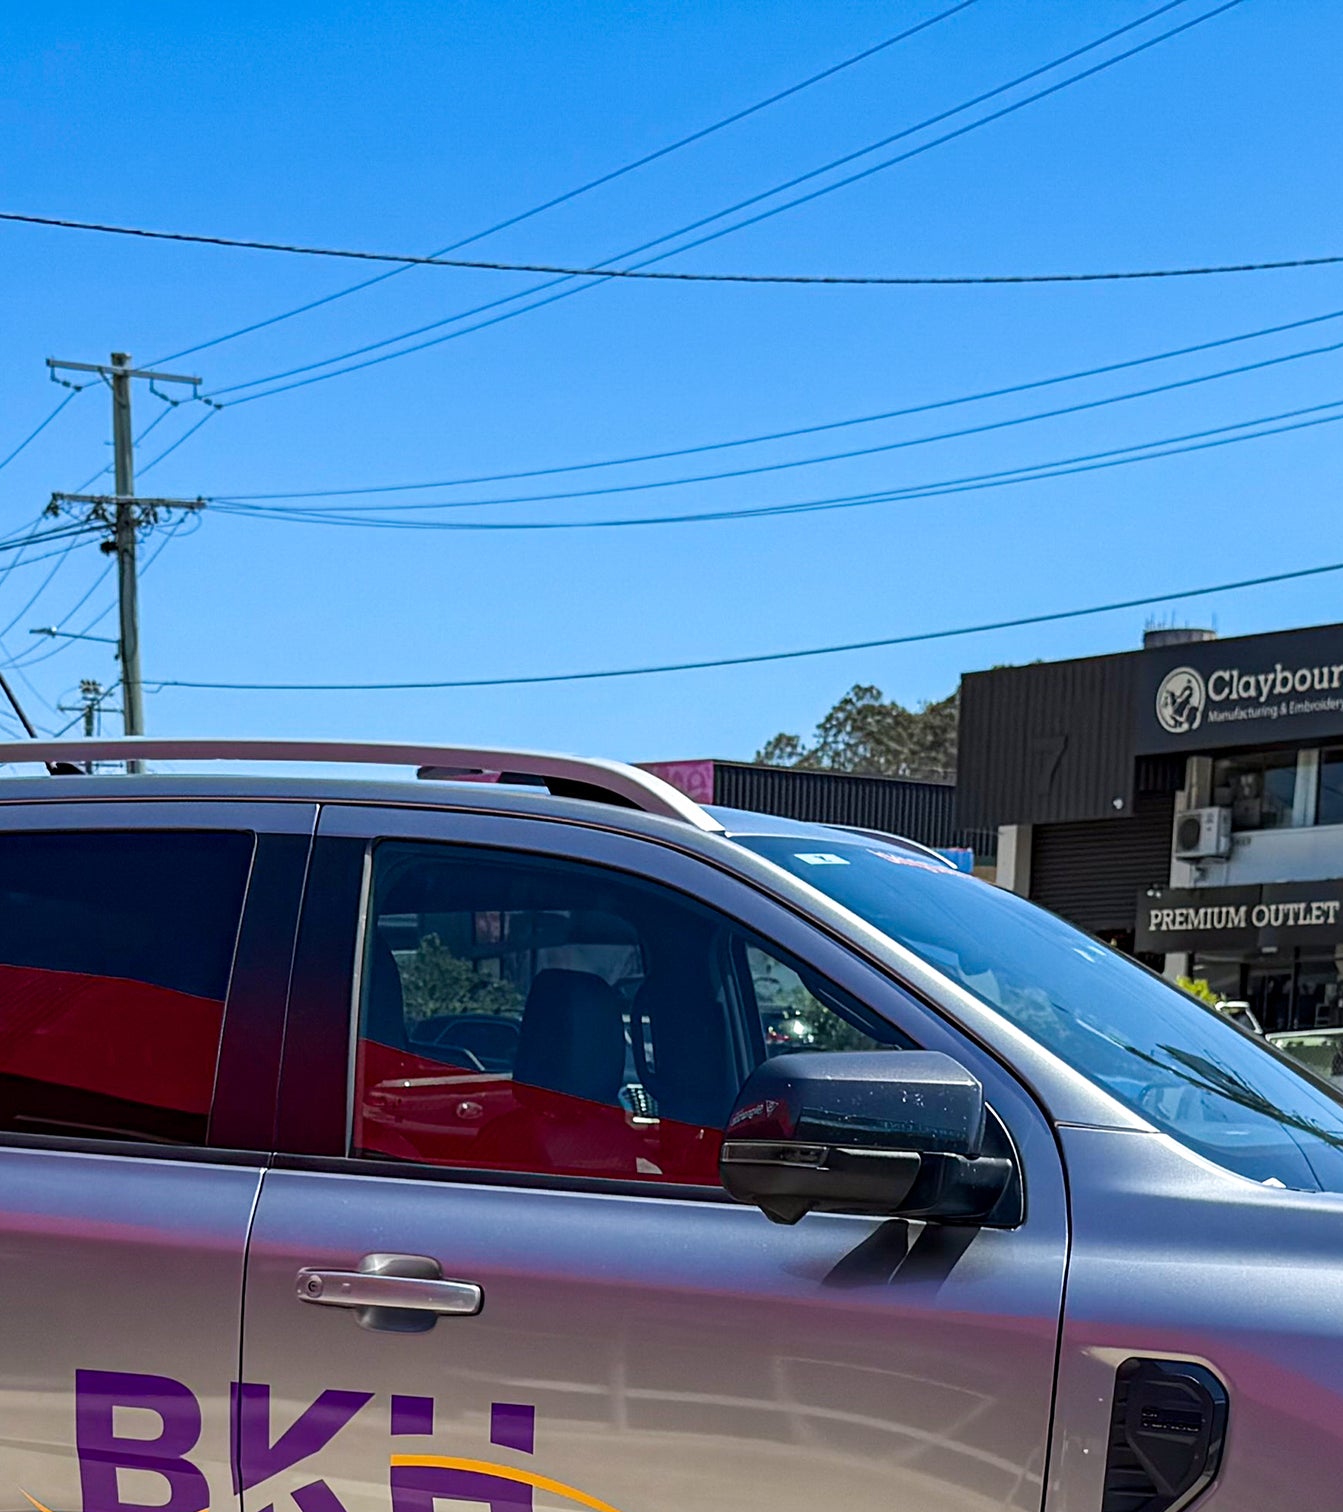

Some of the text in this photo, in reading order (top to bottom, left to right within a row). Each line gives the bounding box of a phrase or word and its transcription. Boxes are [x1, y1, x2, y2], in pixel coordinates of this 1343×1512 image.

[1208, 703, 1278, 723] Manufacturing
[1280, 701, 1288, 715] &
[1149, 901, 1340, 931] PREMIUM OUTLET
